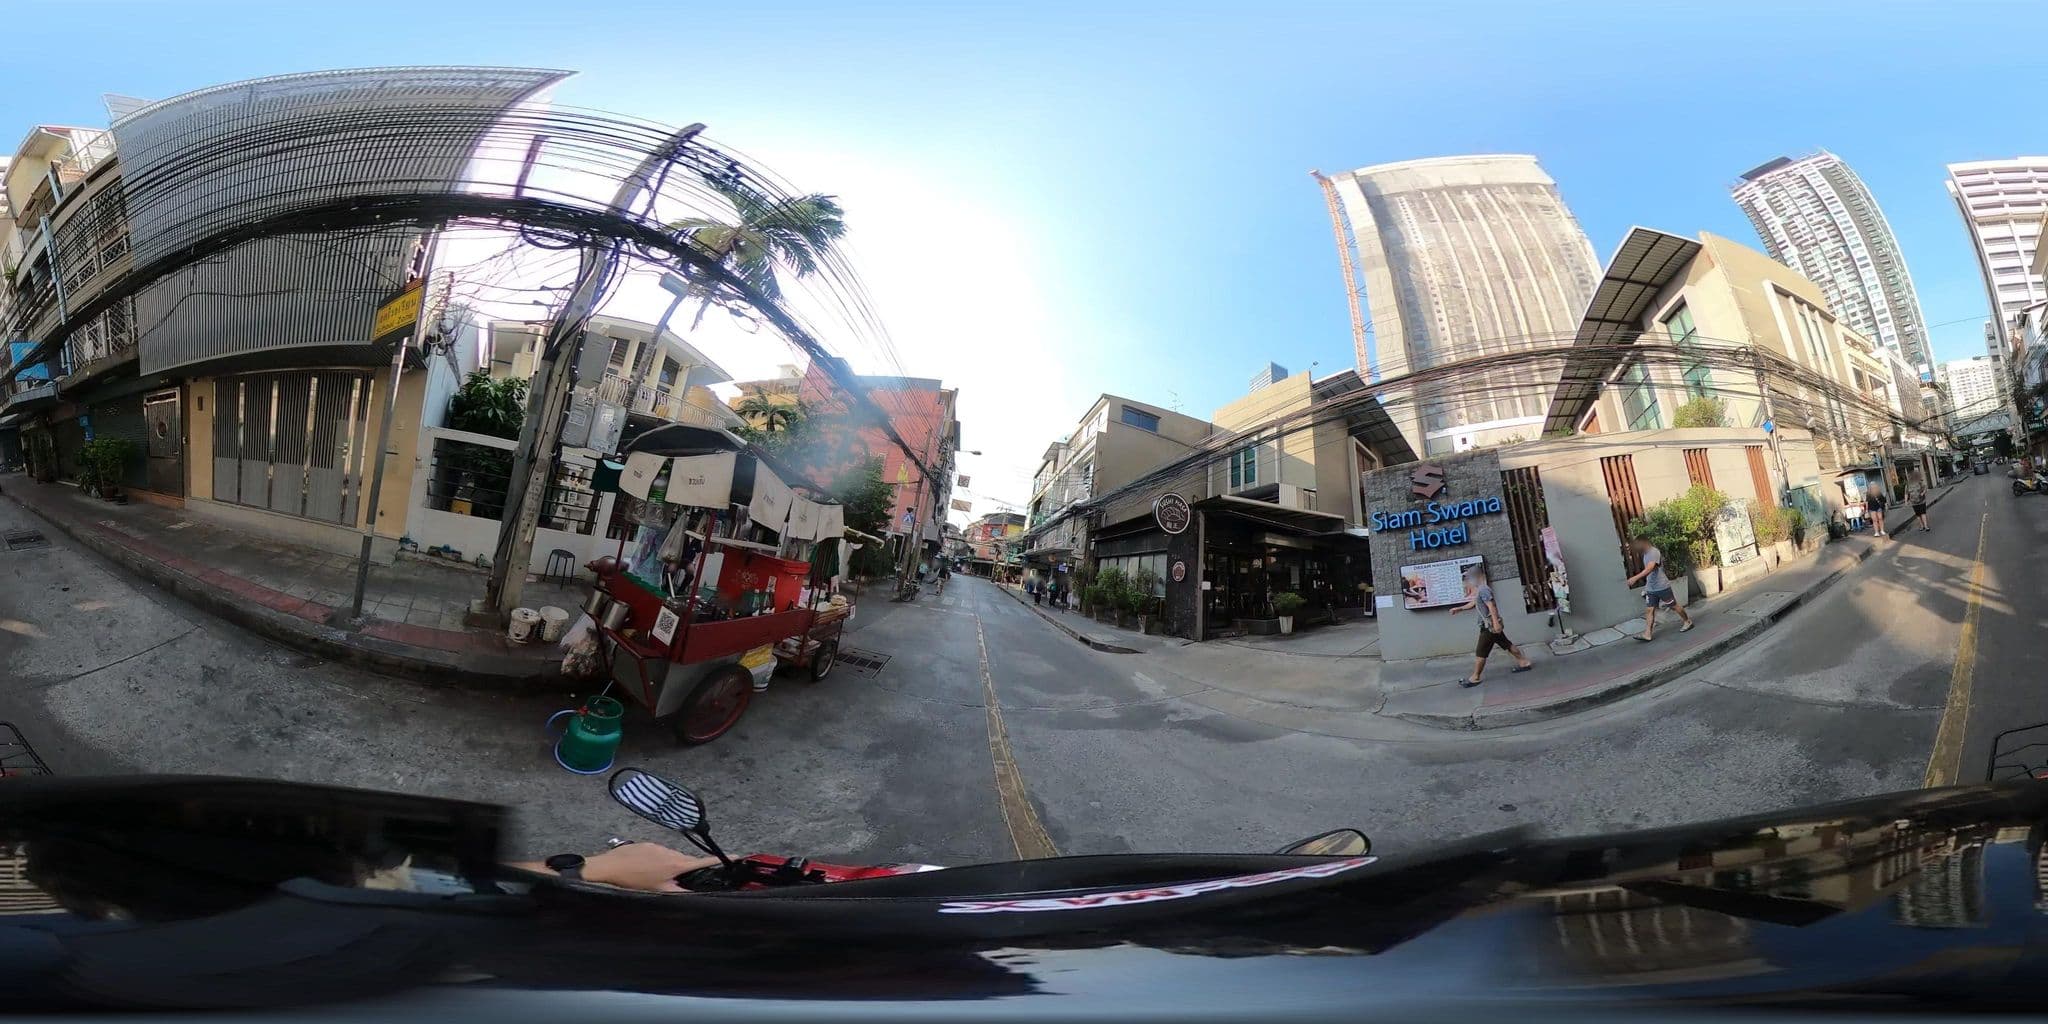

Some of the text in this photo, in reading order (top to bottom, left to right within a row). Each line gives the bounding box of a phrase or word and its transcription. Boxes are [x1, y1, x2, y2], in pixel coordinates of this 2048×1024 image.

[1371, 496, 1501, 532] Siam Swana
[1409, 521, 1468, 550] Hotel
